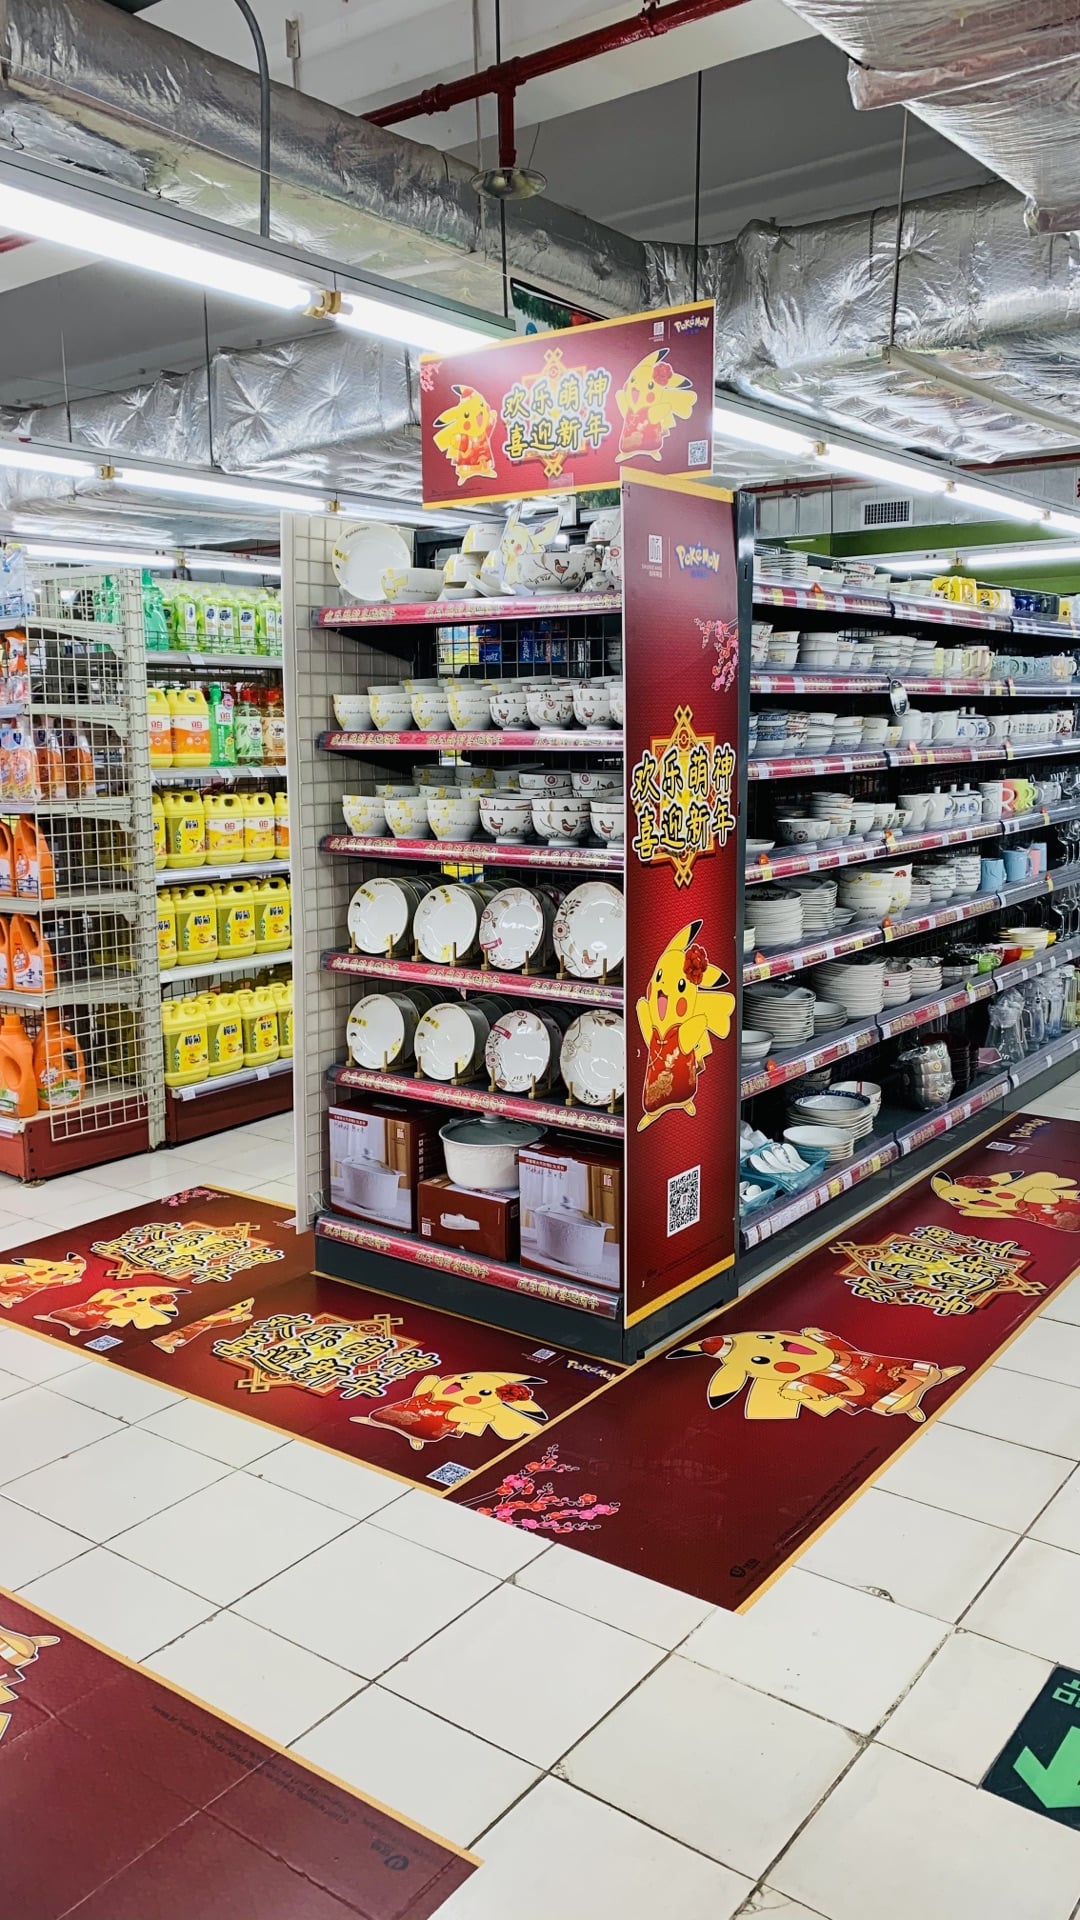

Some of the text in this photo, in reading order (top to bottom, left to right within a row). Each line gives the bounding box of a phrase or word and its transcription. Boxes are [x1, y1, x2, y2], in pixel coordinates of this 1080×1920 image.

[503, 367, 612, 419] 欢乐萌神
[502, 407, 611, 460] 喜迎新年
[632, 743, 735, 799] 欢乐萌神
[633, 798, 735, 861] 喜迎新年
[846, 1226, 971, 1302] 欢乐萌神
[902, 1241, 1030, 1315] 喜迎新年
[213, 1332, 388, 1399] 喜迎新年
[255, 1314, 441, 1375] 欢乐萌神
